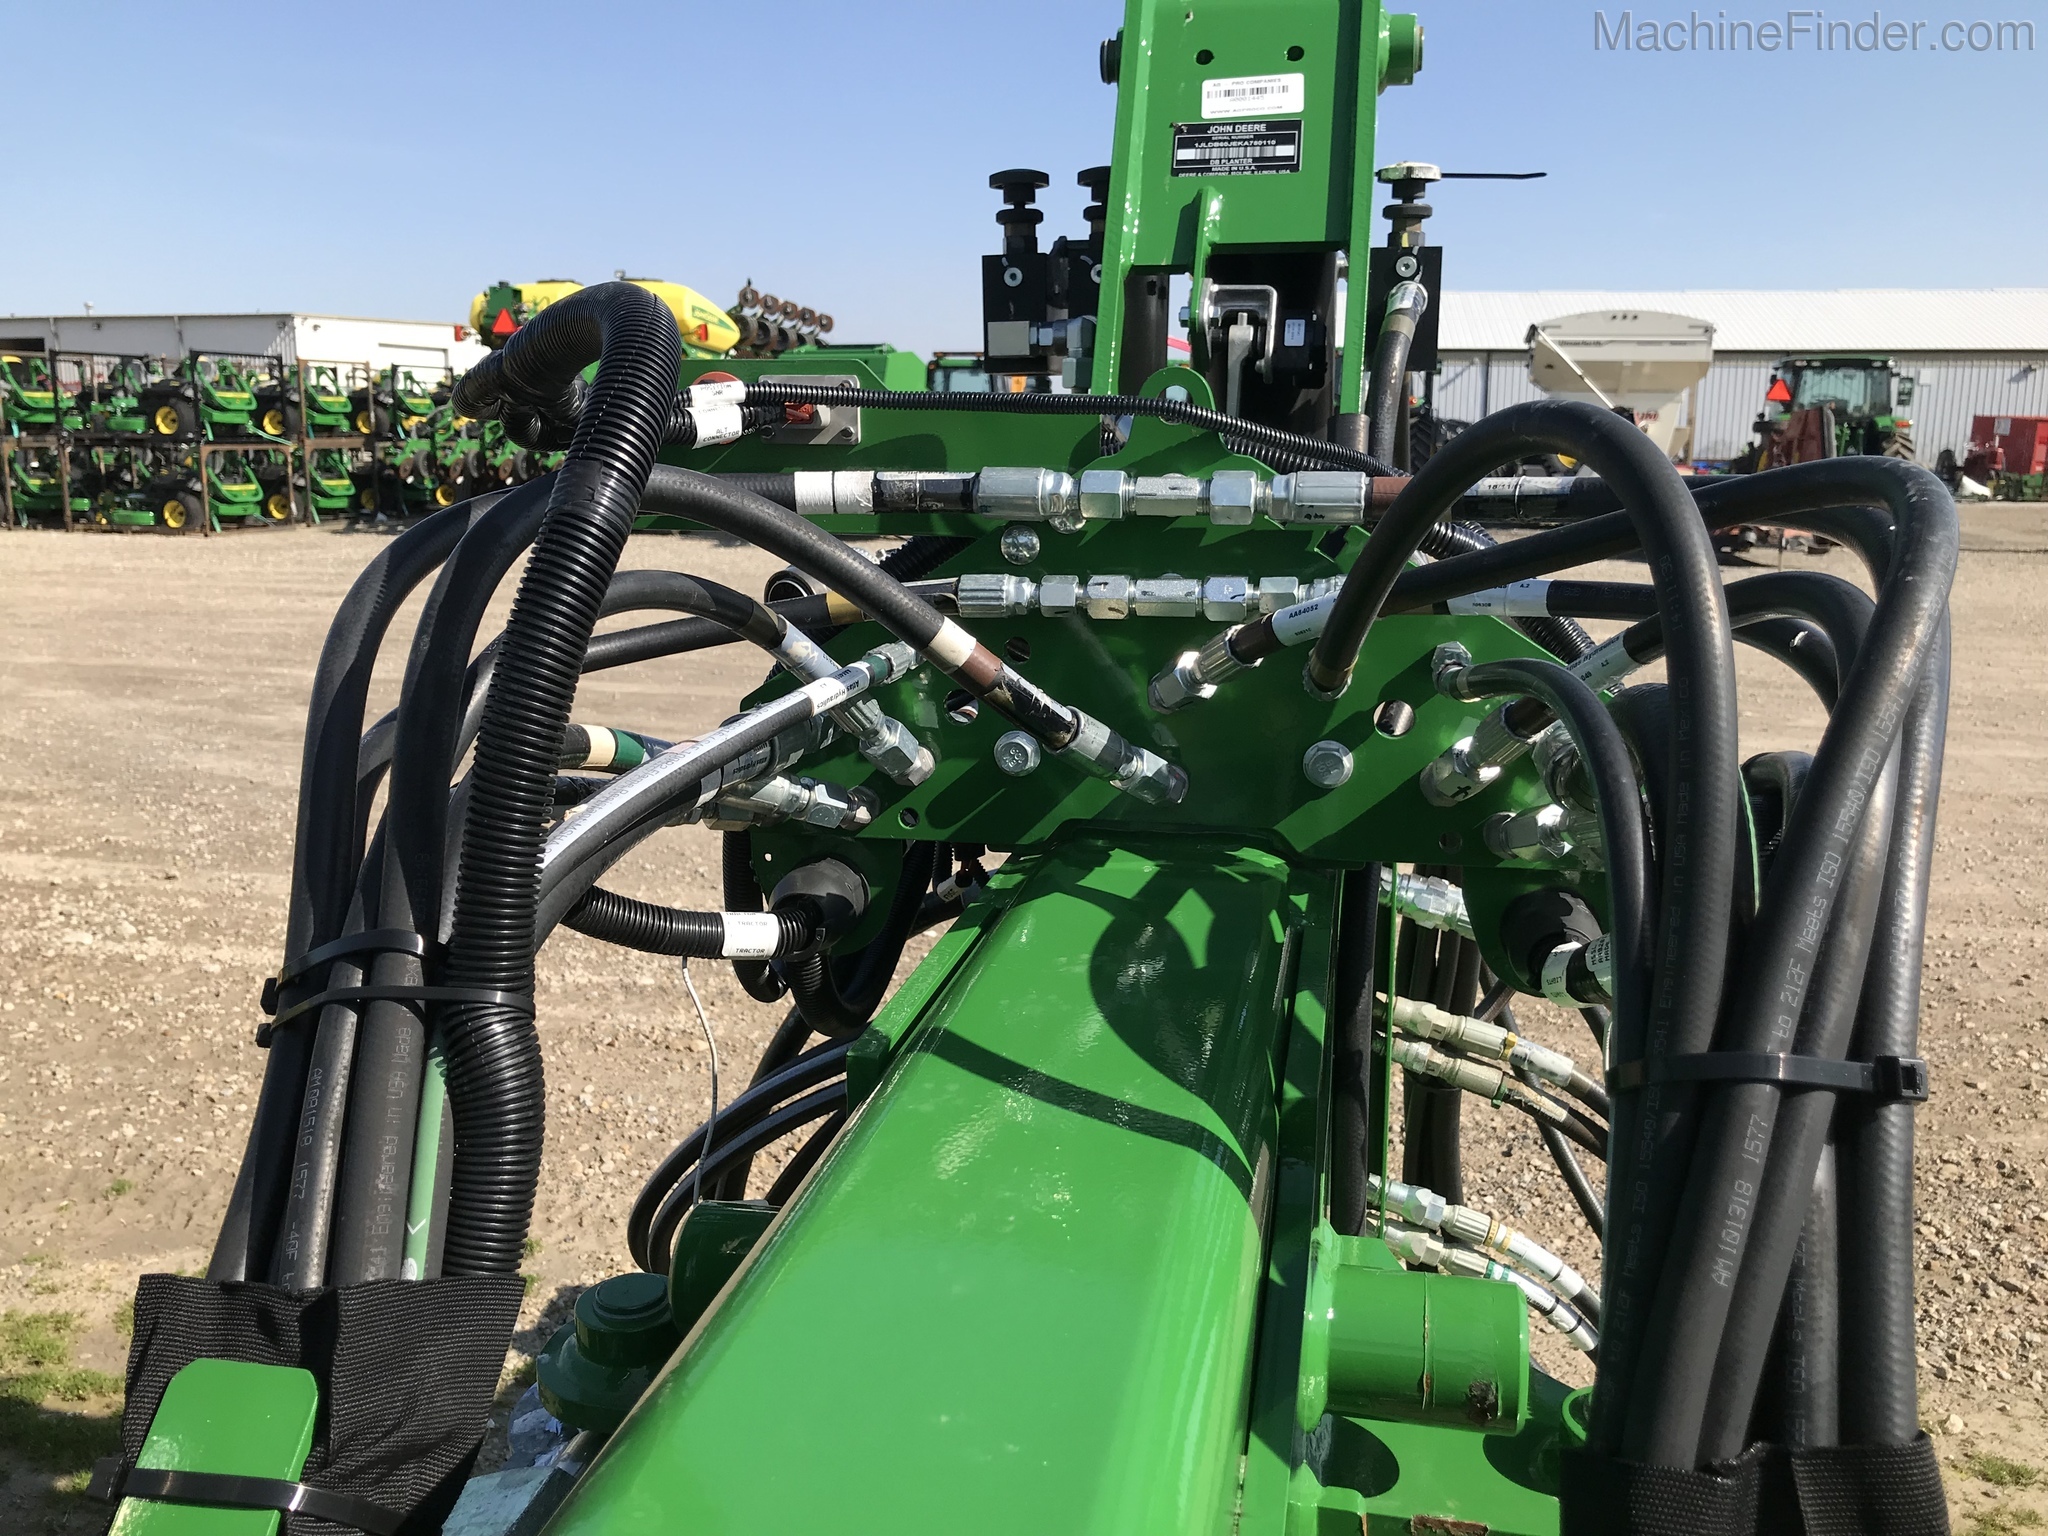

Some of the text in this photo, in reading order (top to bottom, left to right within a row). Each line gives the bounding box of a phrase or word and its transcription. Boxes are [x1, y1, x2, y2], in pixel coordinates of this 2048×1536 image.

[1207, 123, 1267, 134] JOHN DEERE
[702, 429, 740, 442] CONNECTOR
[816, 688, 846, 709] Hydraulics
[1870, 690, 1904, 742] 15541
[1815, 850, 1842, 888] ISO
[1797, 894, 1827, 953] Meets
[1779, 961, 1807, 1007] 212F
[1771, 1013, 1793, 1038] to
[391, 1026, 412, 1063] Made
[386, 1070, 405, 1099] USA
[386, 1106, 401, 1123] in
[292, 1161, 308, 1199] 1577
[1707, 1113, 1769, 1286] AM101318 1577
[282, 1221, 302, 1260] -40F
